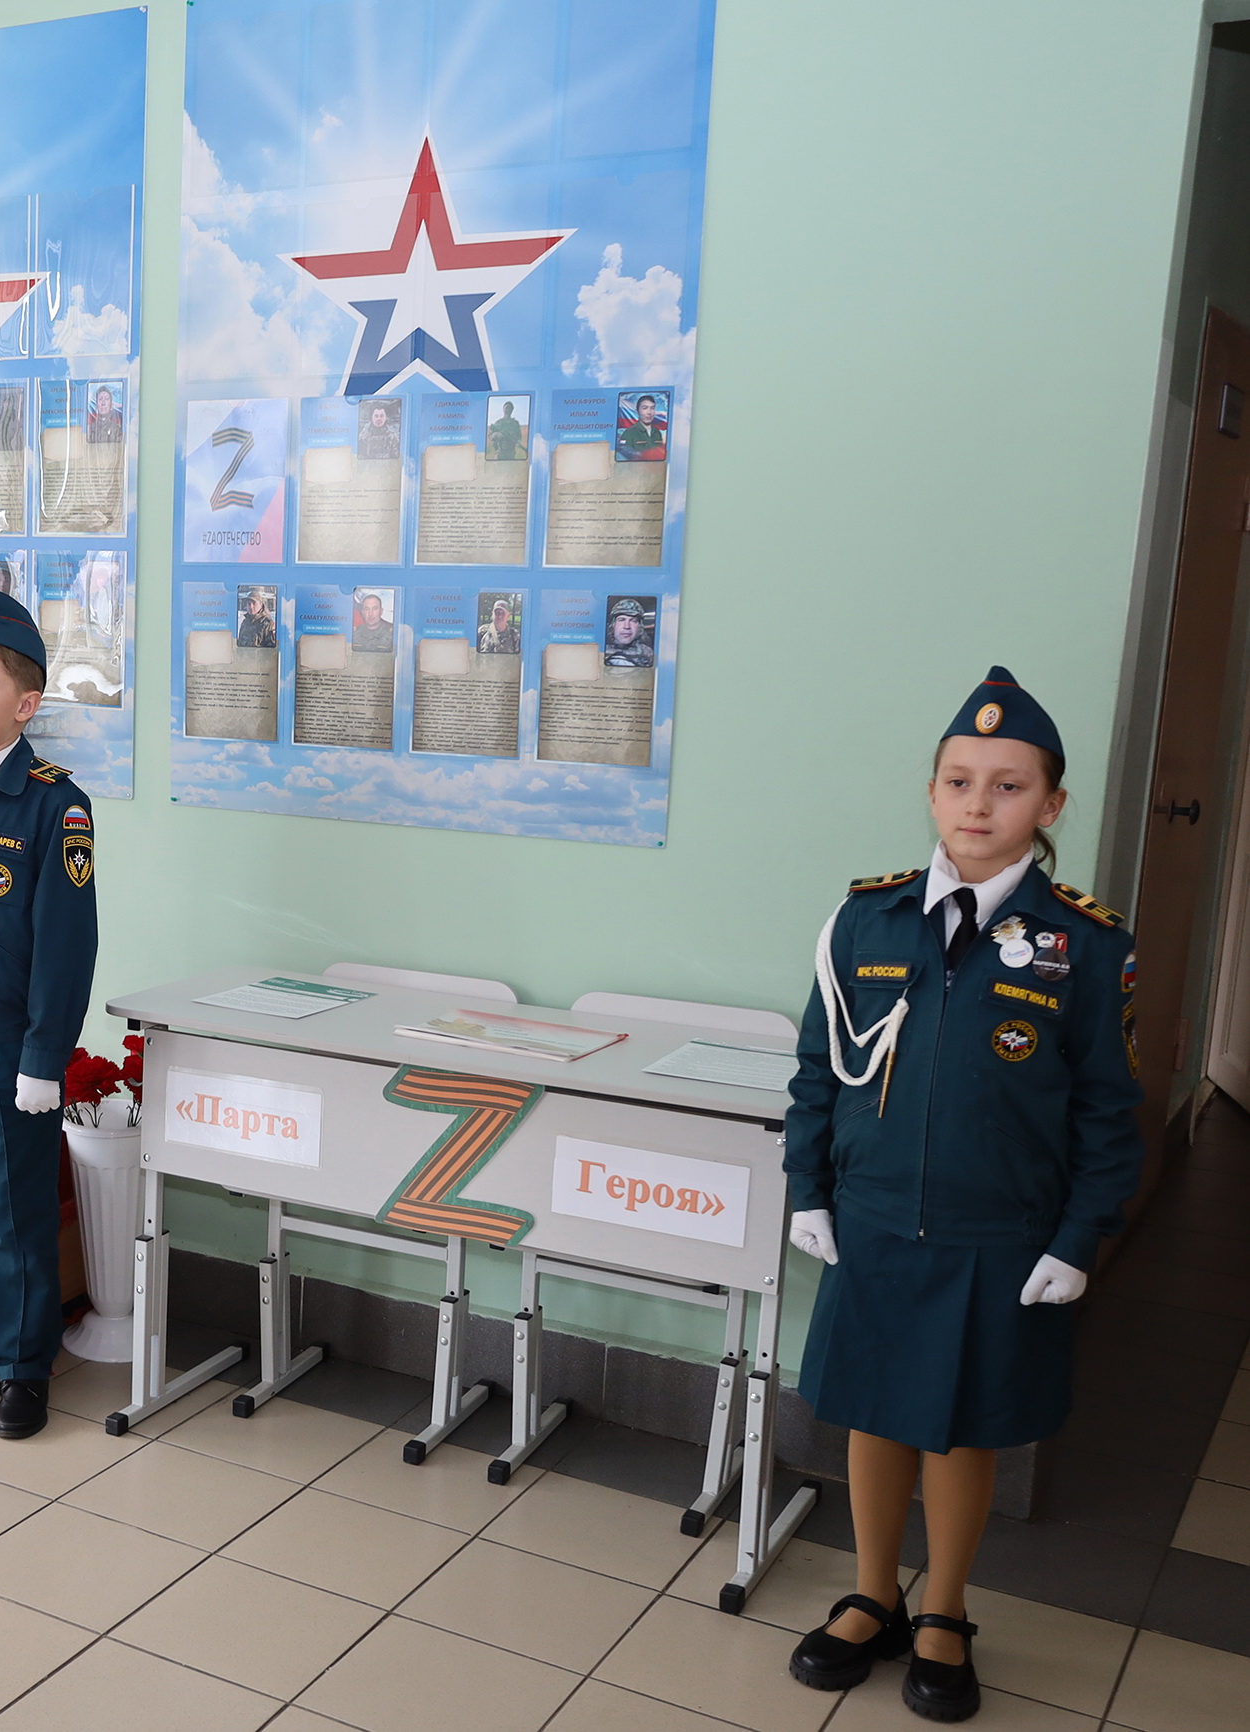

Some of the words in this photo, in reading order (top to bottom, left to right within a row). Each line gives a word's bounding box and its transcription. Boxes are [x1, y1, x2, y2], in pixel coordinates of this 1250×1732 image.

[16, 841, 22, 850] С.
[856, 966, 872, 977] МЧС
[873, 966, 907, 977] РОССИИ
[174, 1092, 299, 1141] «Парта
[575, 1158, 726, 1218] Героя»
